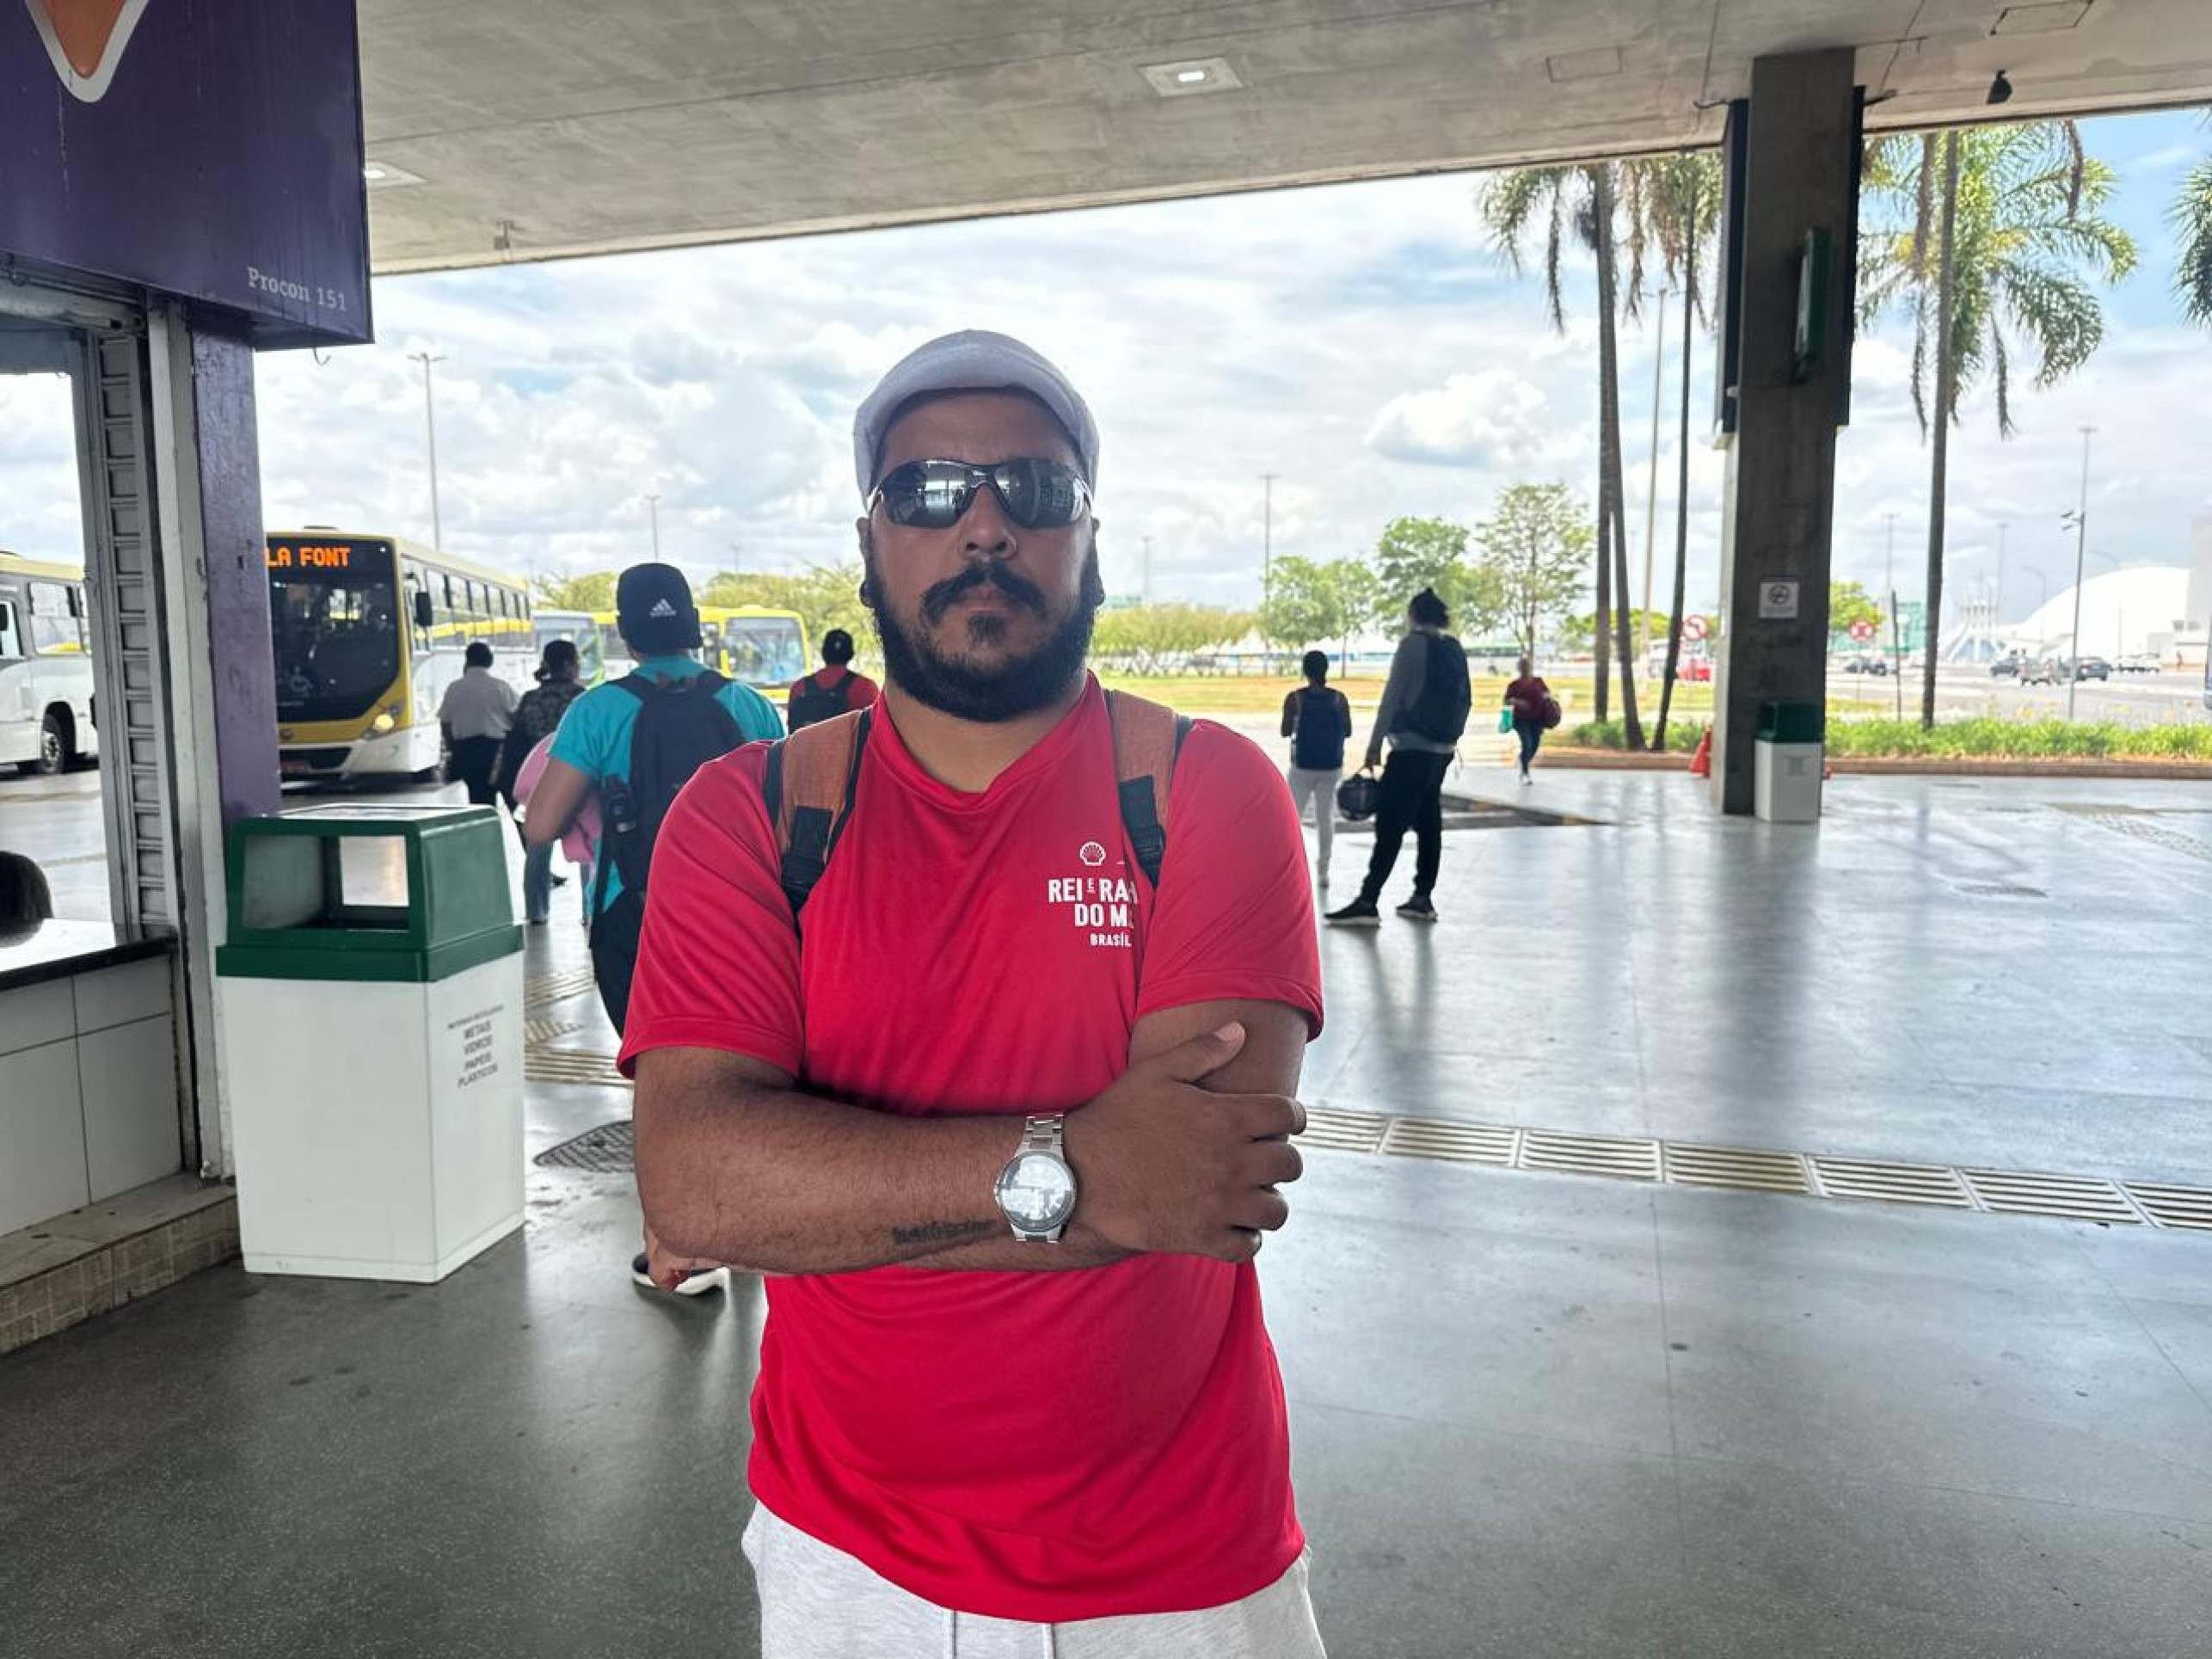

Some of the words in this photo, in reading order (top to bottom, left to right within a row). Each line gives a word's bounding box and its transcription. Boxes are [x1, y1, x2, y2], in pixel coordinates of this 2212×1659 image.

[247, 266, 310, 304] Procon
[316, 286, 347, 312] 151
[299, 546, 352, 568] FONT
[1048, 877, 1083, 903] REI
[1074, 903, 1104, 927] DO
[1090, 931, 1133, 948] BRASIL
